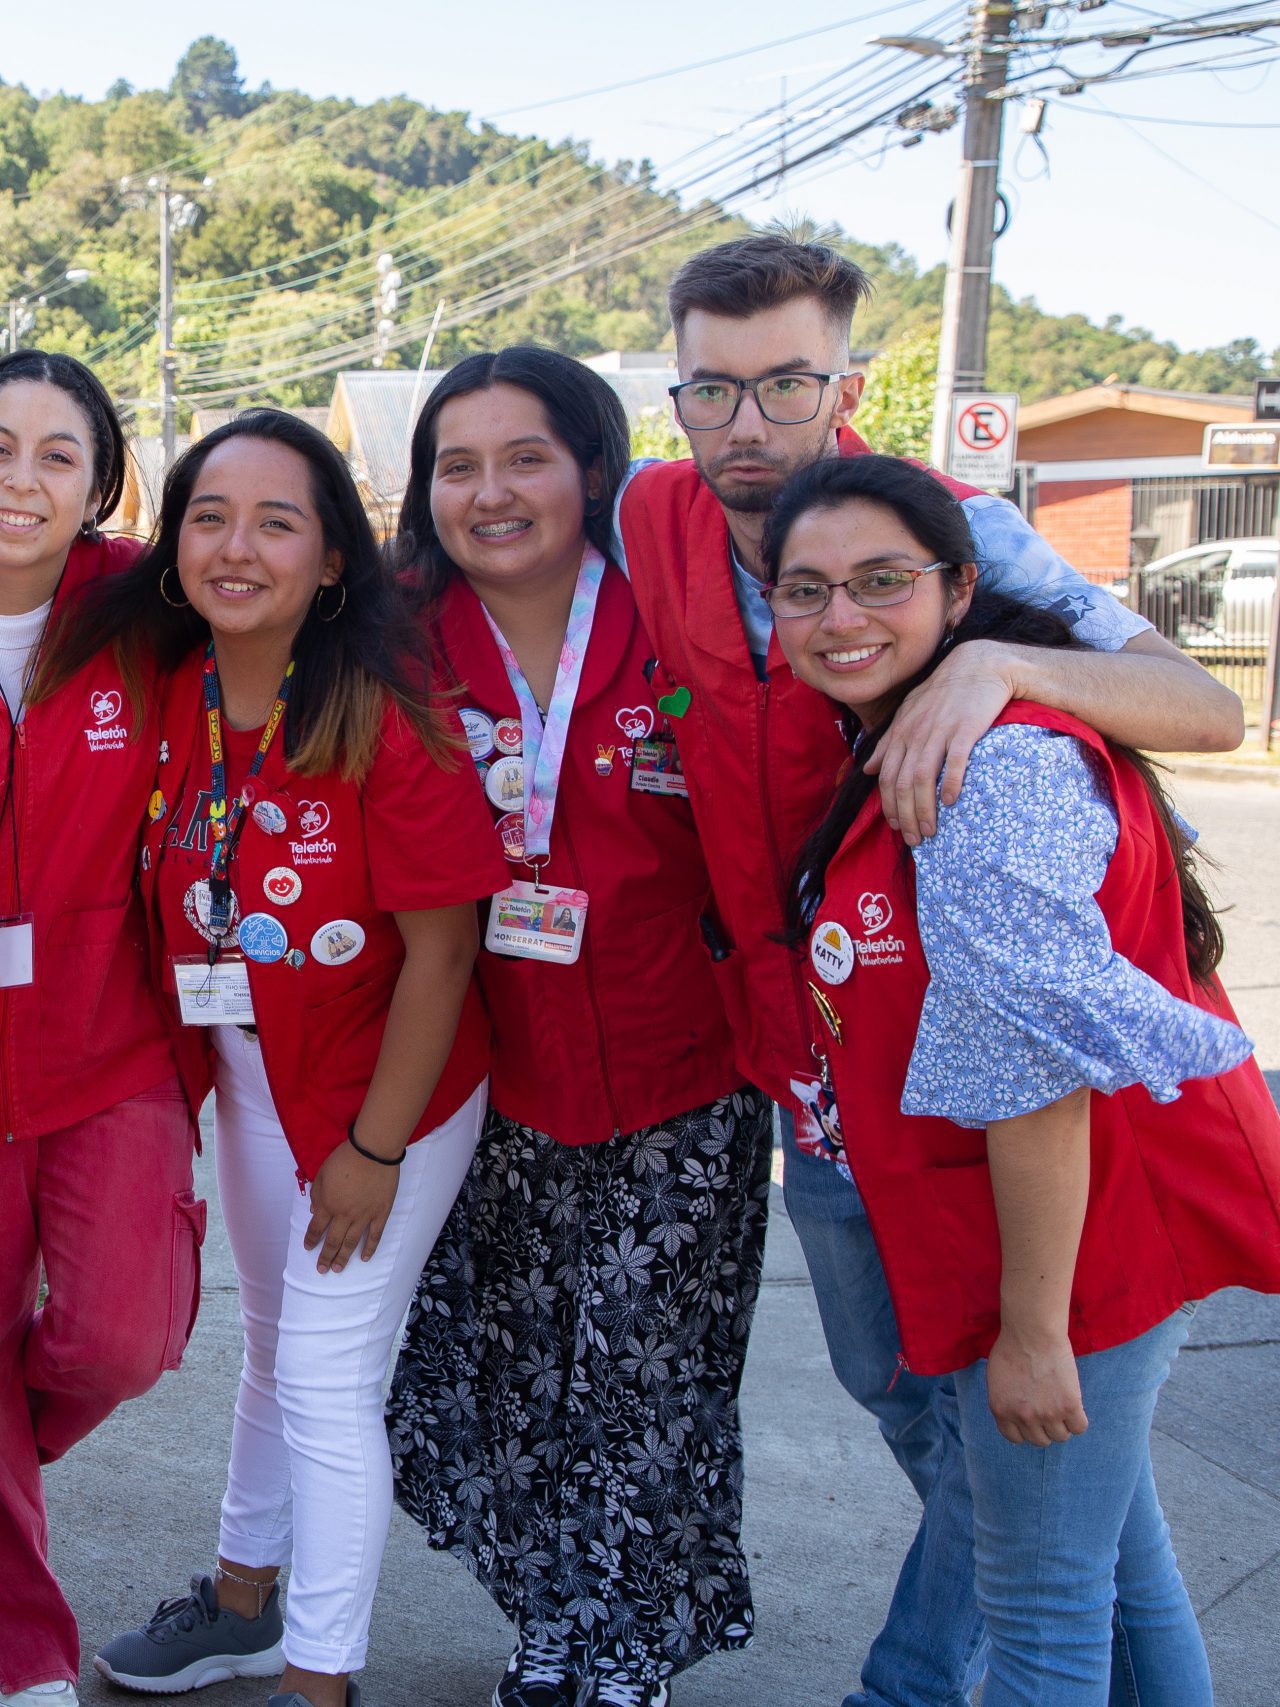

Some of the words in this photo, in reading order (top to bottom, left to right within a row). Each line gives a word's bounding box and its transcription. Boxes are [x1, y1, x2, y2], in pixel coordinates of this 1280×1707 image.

[84, 725, 127, 741] Teletón
[288, 838, 337, 854] Teletón
[509, 904, 531, 914] Teletón
[852, 934, 905, 954] Teletón
[815, 943, 843, 970] KATTY
